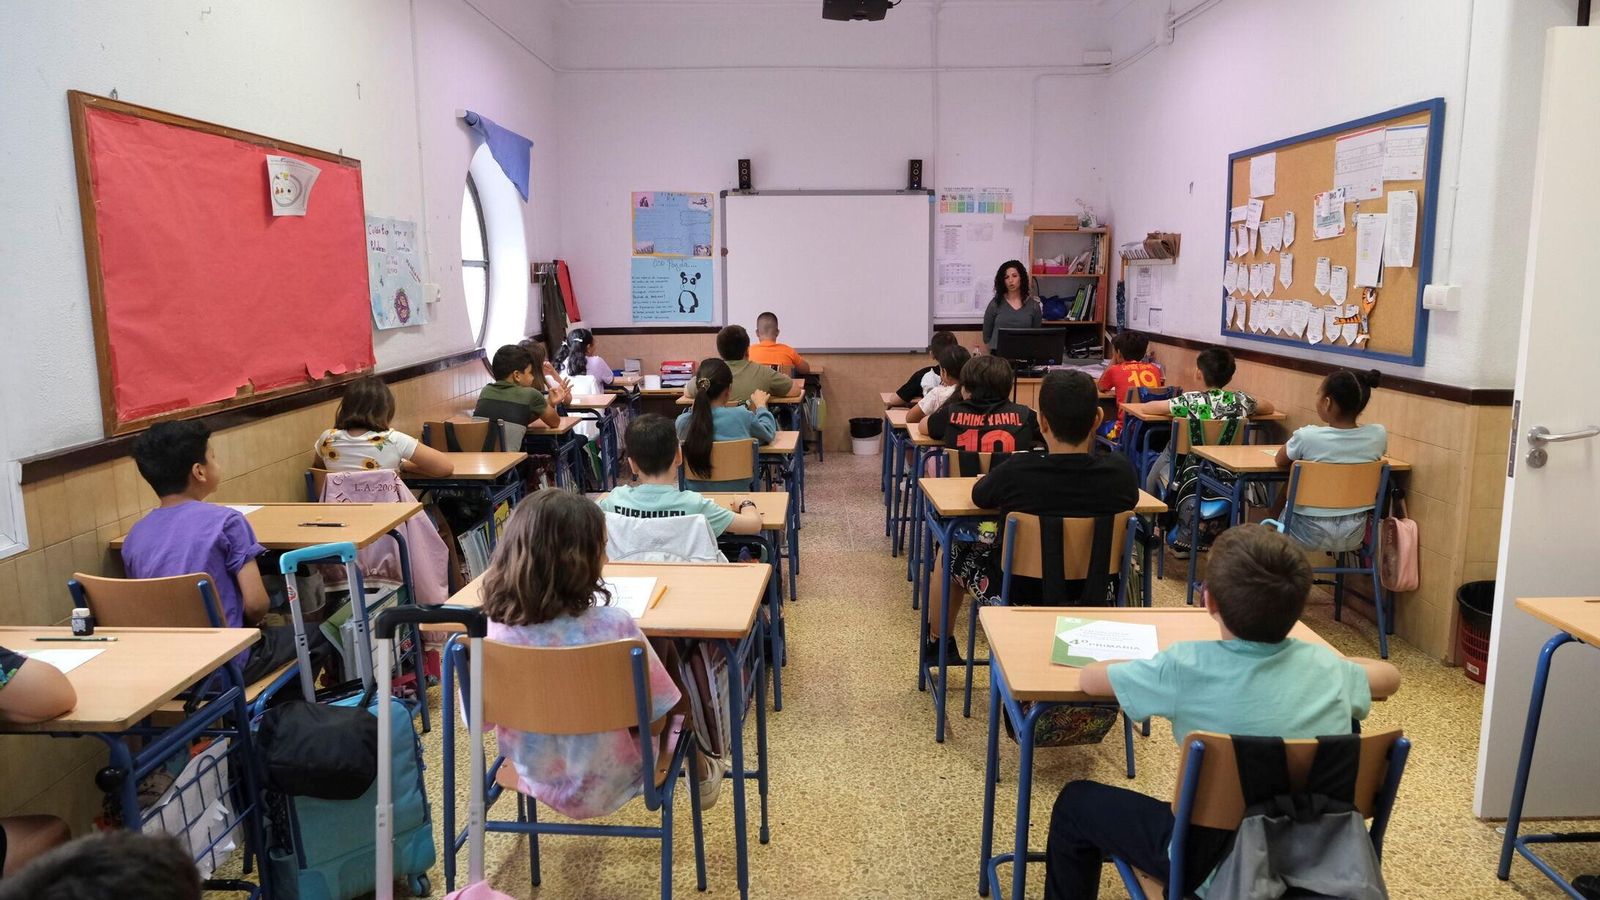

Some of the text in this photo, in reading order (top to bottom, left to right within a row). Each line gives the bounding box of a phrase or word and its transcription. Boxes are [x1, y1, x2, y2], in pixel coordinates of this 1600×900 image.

[950, 412, 1023, 426] LAMINE YAMAL
[957, 429, 1015, 453] 10
